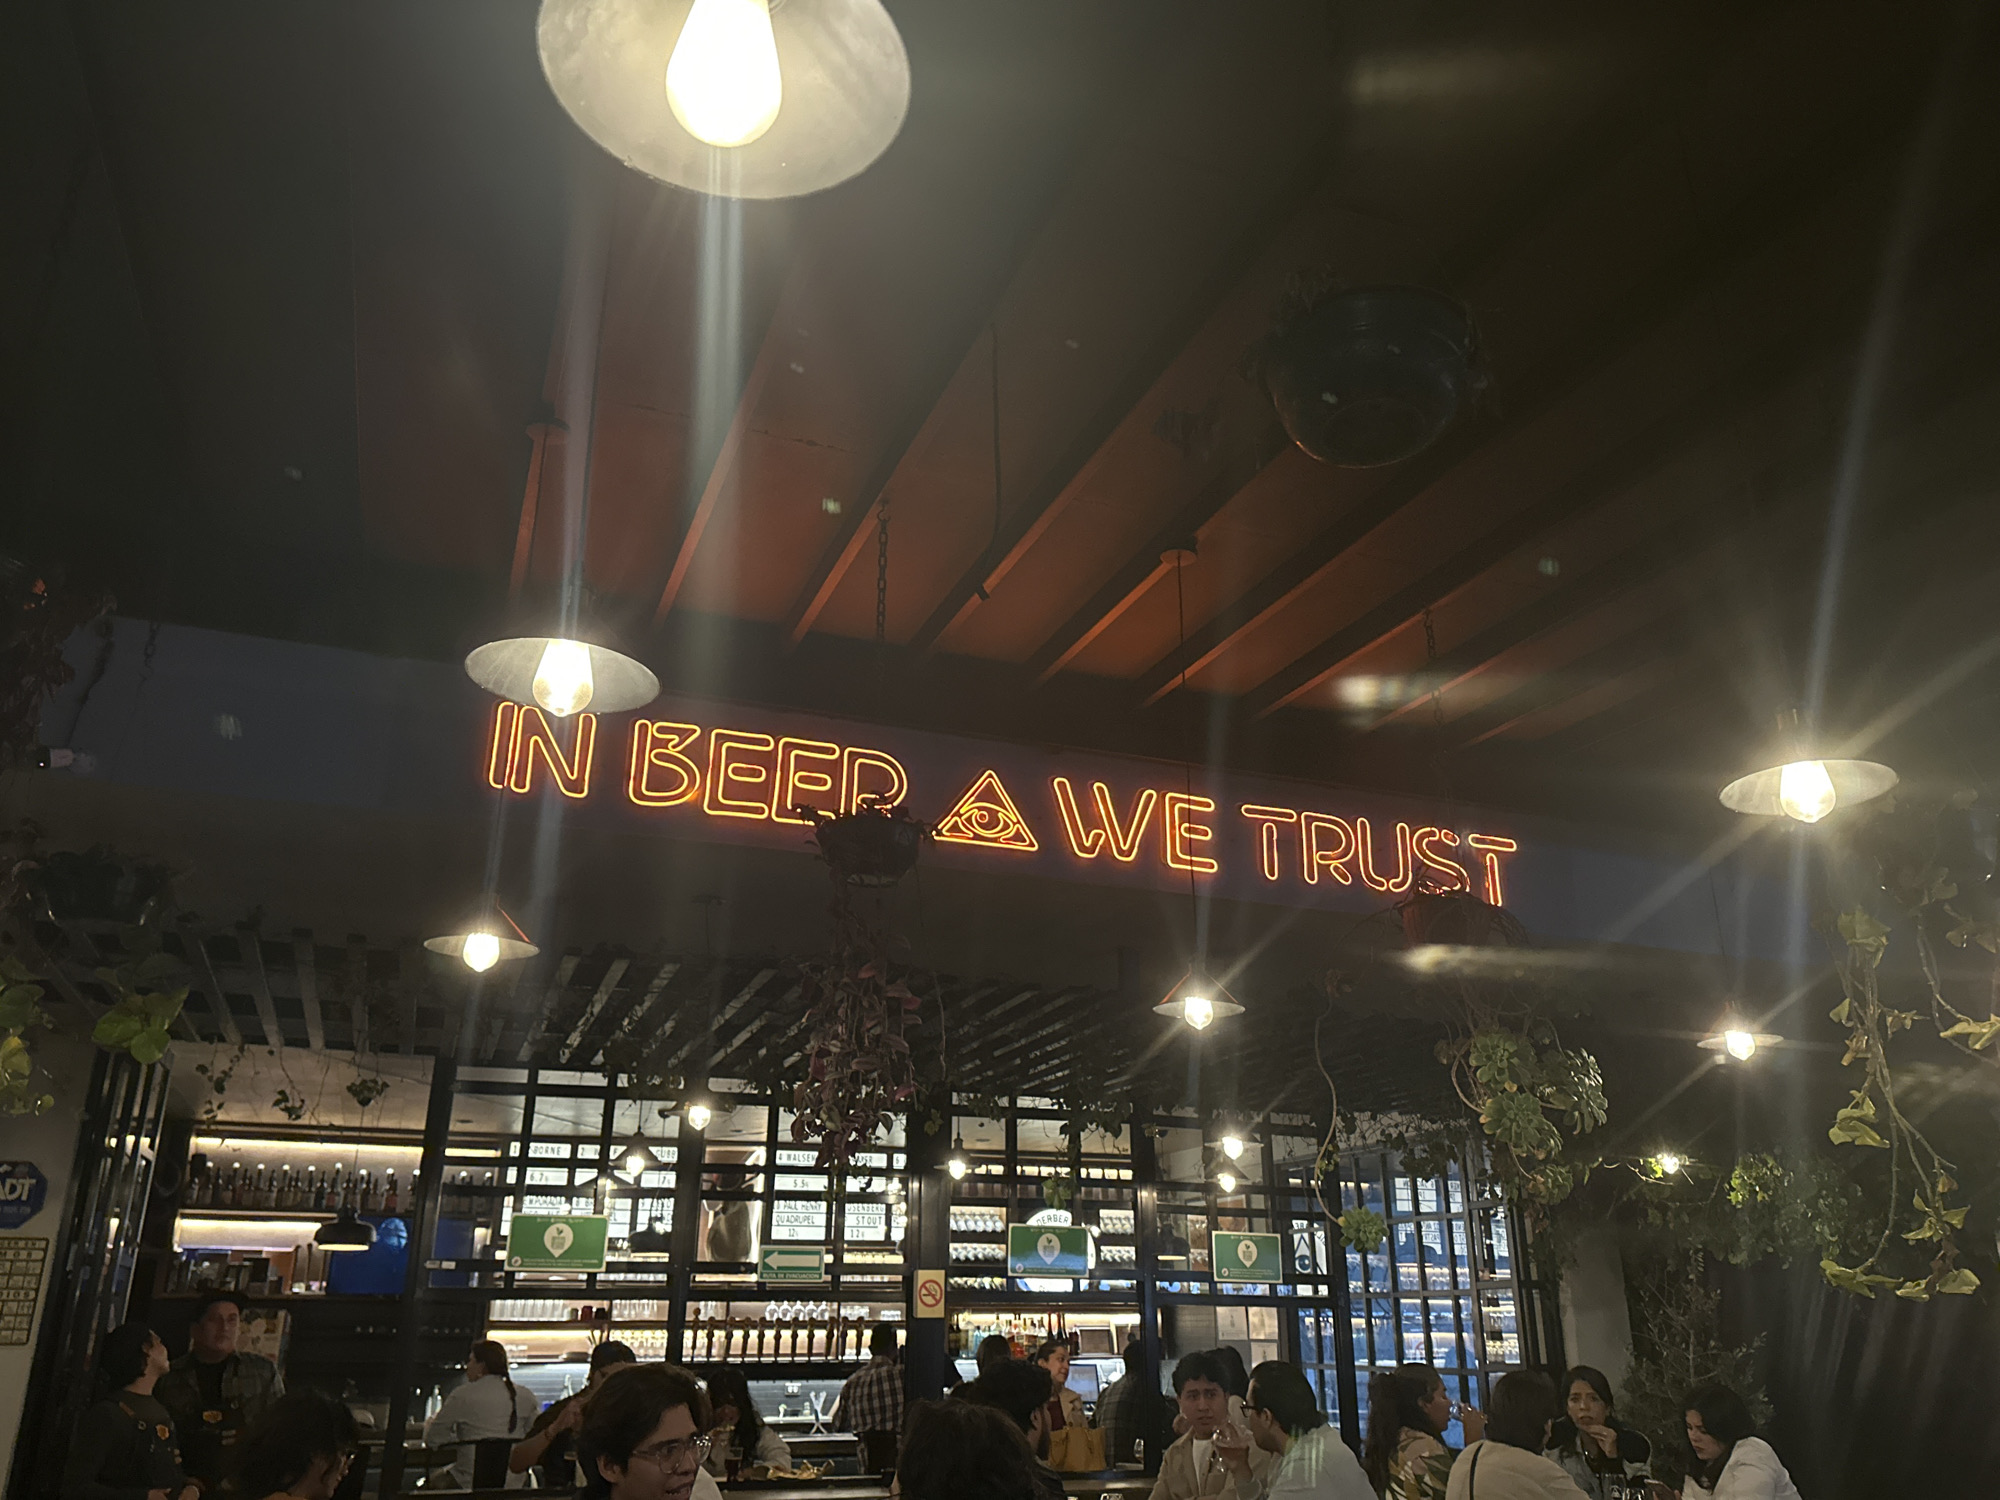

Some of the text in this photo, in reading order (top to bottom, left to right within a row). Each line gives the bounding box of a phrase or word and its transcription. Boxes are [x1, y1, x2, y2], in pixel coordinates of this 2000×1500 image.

[488, 701, 1518, 907] IN BEER WE TRUST
[856, 1216, 883, 1226] STOUT
